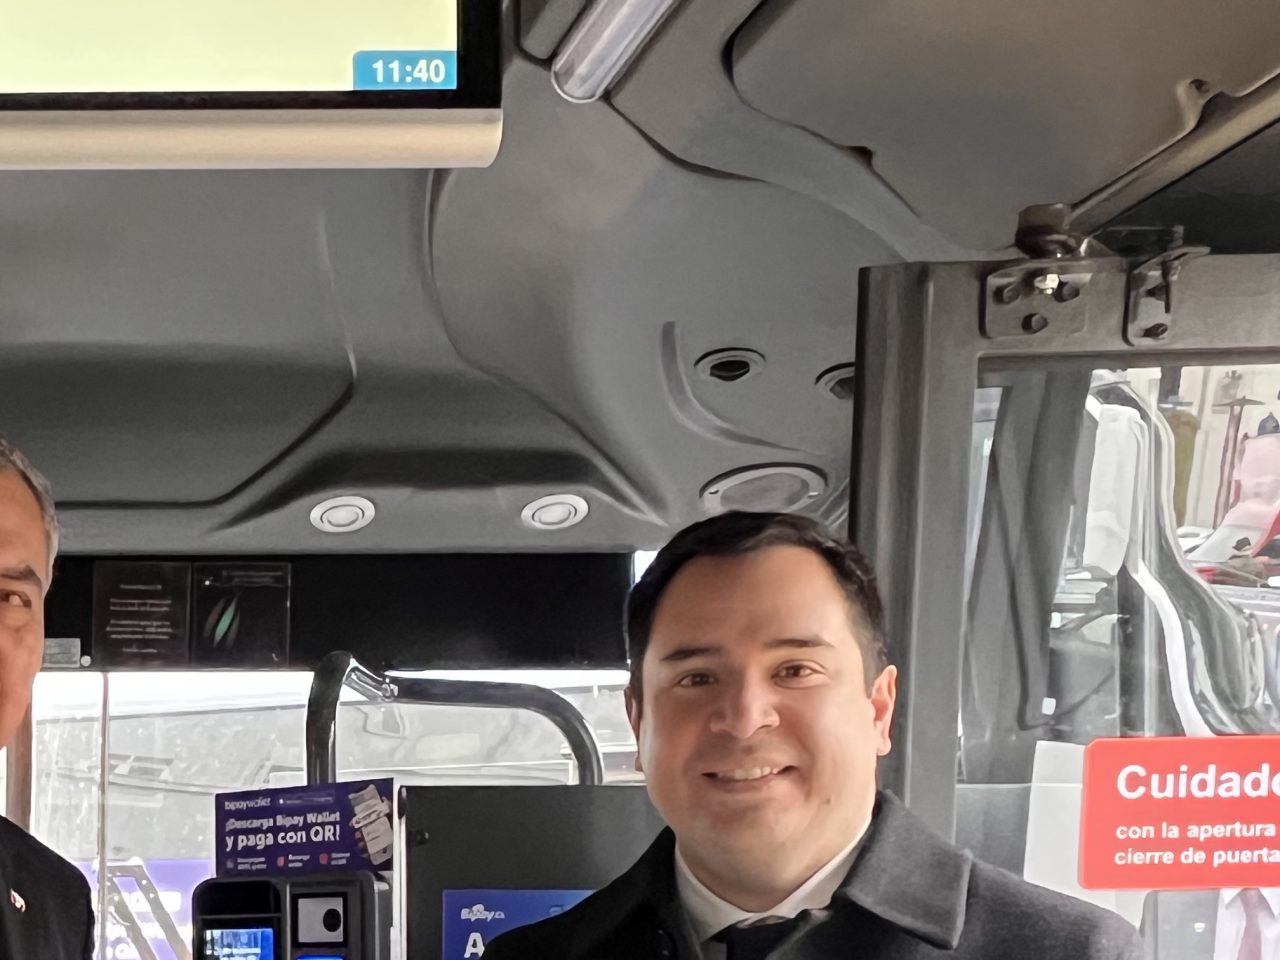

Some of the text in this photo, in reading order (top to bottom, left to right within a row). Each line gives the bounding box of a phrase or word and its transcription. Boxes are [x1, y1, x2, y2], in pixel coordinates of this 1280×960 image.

[372, 59, 446, 83] 11:40
[306, 811, 341, 824] Wallet
[225, 824, 341, 852] y paga con QR!
[1115, 821, 1276, 841] con la apertura
[1114, 848, 1175, 865] cierre
[1180, 847, 1206, 864] de
